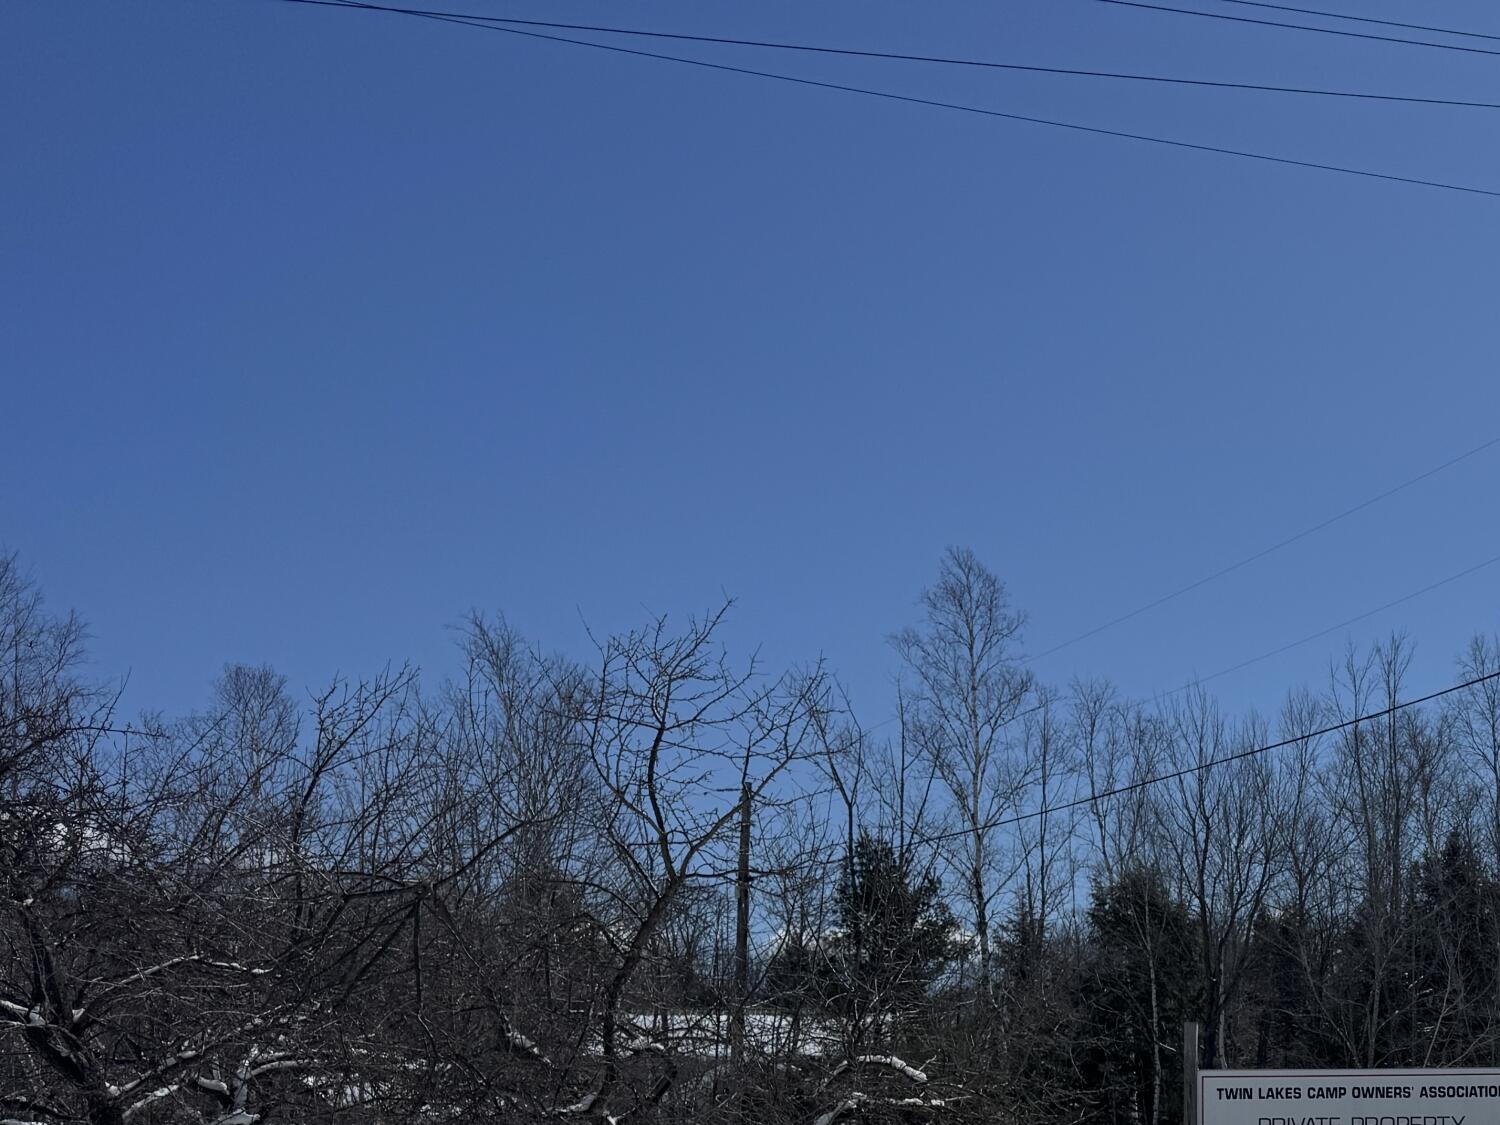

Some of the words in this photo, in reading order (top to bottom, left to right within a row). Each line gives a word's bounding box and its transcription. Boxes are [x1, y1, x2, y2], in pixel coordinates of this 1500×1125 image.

[1217, 1088, 1253, 1100] TWIN
[1258, 1087, 1302, 1100] LAKES
[1307, 1087, 1347, 1099] CAMP
[1352, 1086, 1414, 1099] OWNERS'
